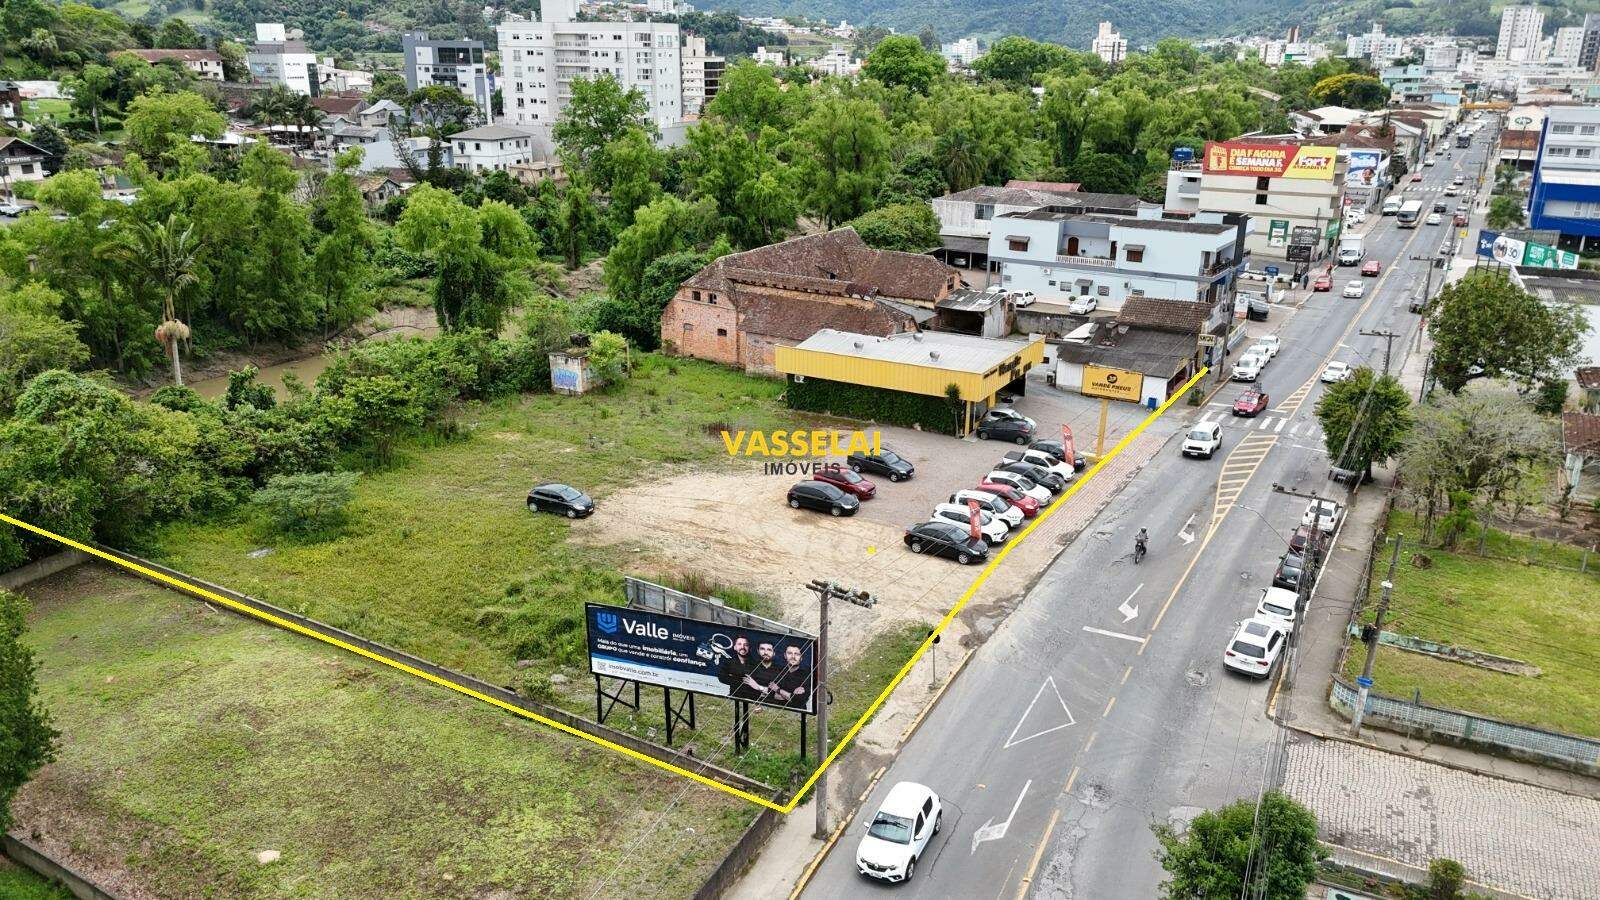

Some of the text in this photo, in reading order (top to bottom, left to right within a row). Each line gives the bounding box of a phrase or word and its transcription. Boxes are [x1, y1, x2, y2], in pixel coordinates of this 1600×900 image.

[1231, 149, 1246, 158] DIA
[1251, 150, 1286, 159] AGORA
[1236, 157, 1276, 167] SEMANA
[1298, 155, 1328, 167] Fort
[622, 618, 669, 640] Valle
[672, 633, 695, 641] IMÓVEIS
[628, 649, 645, 657] vende
